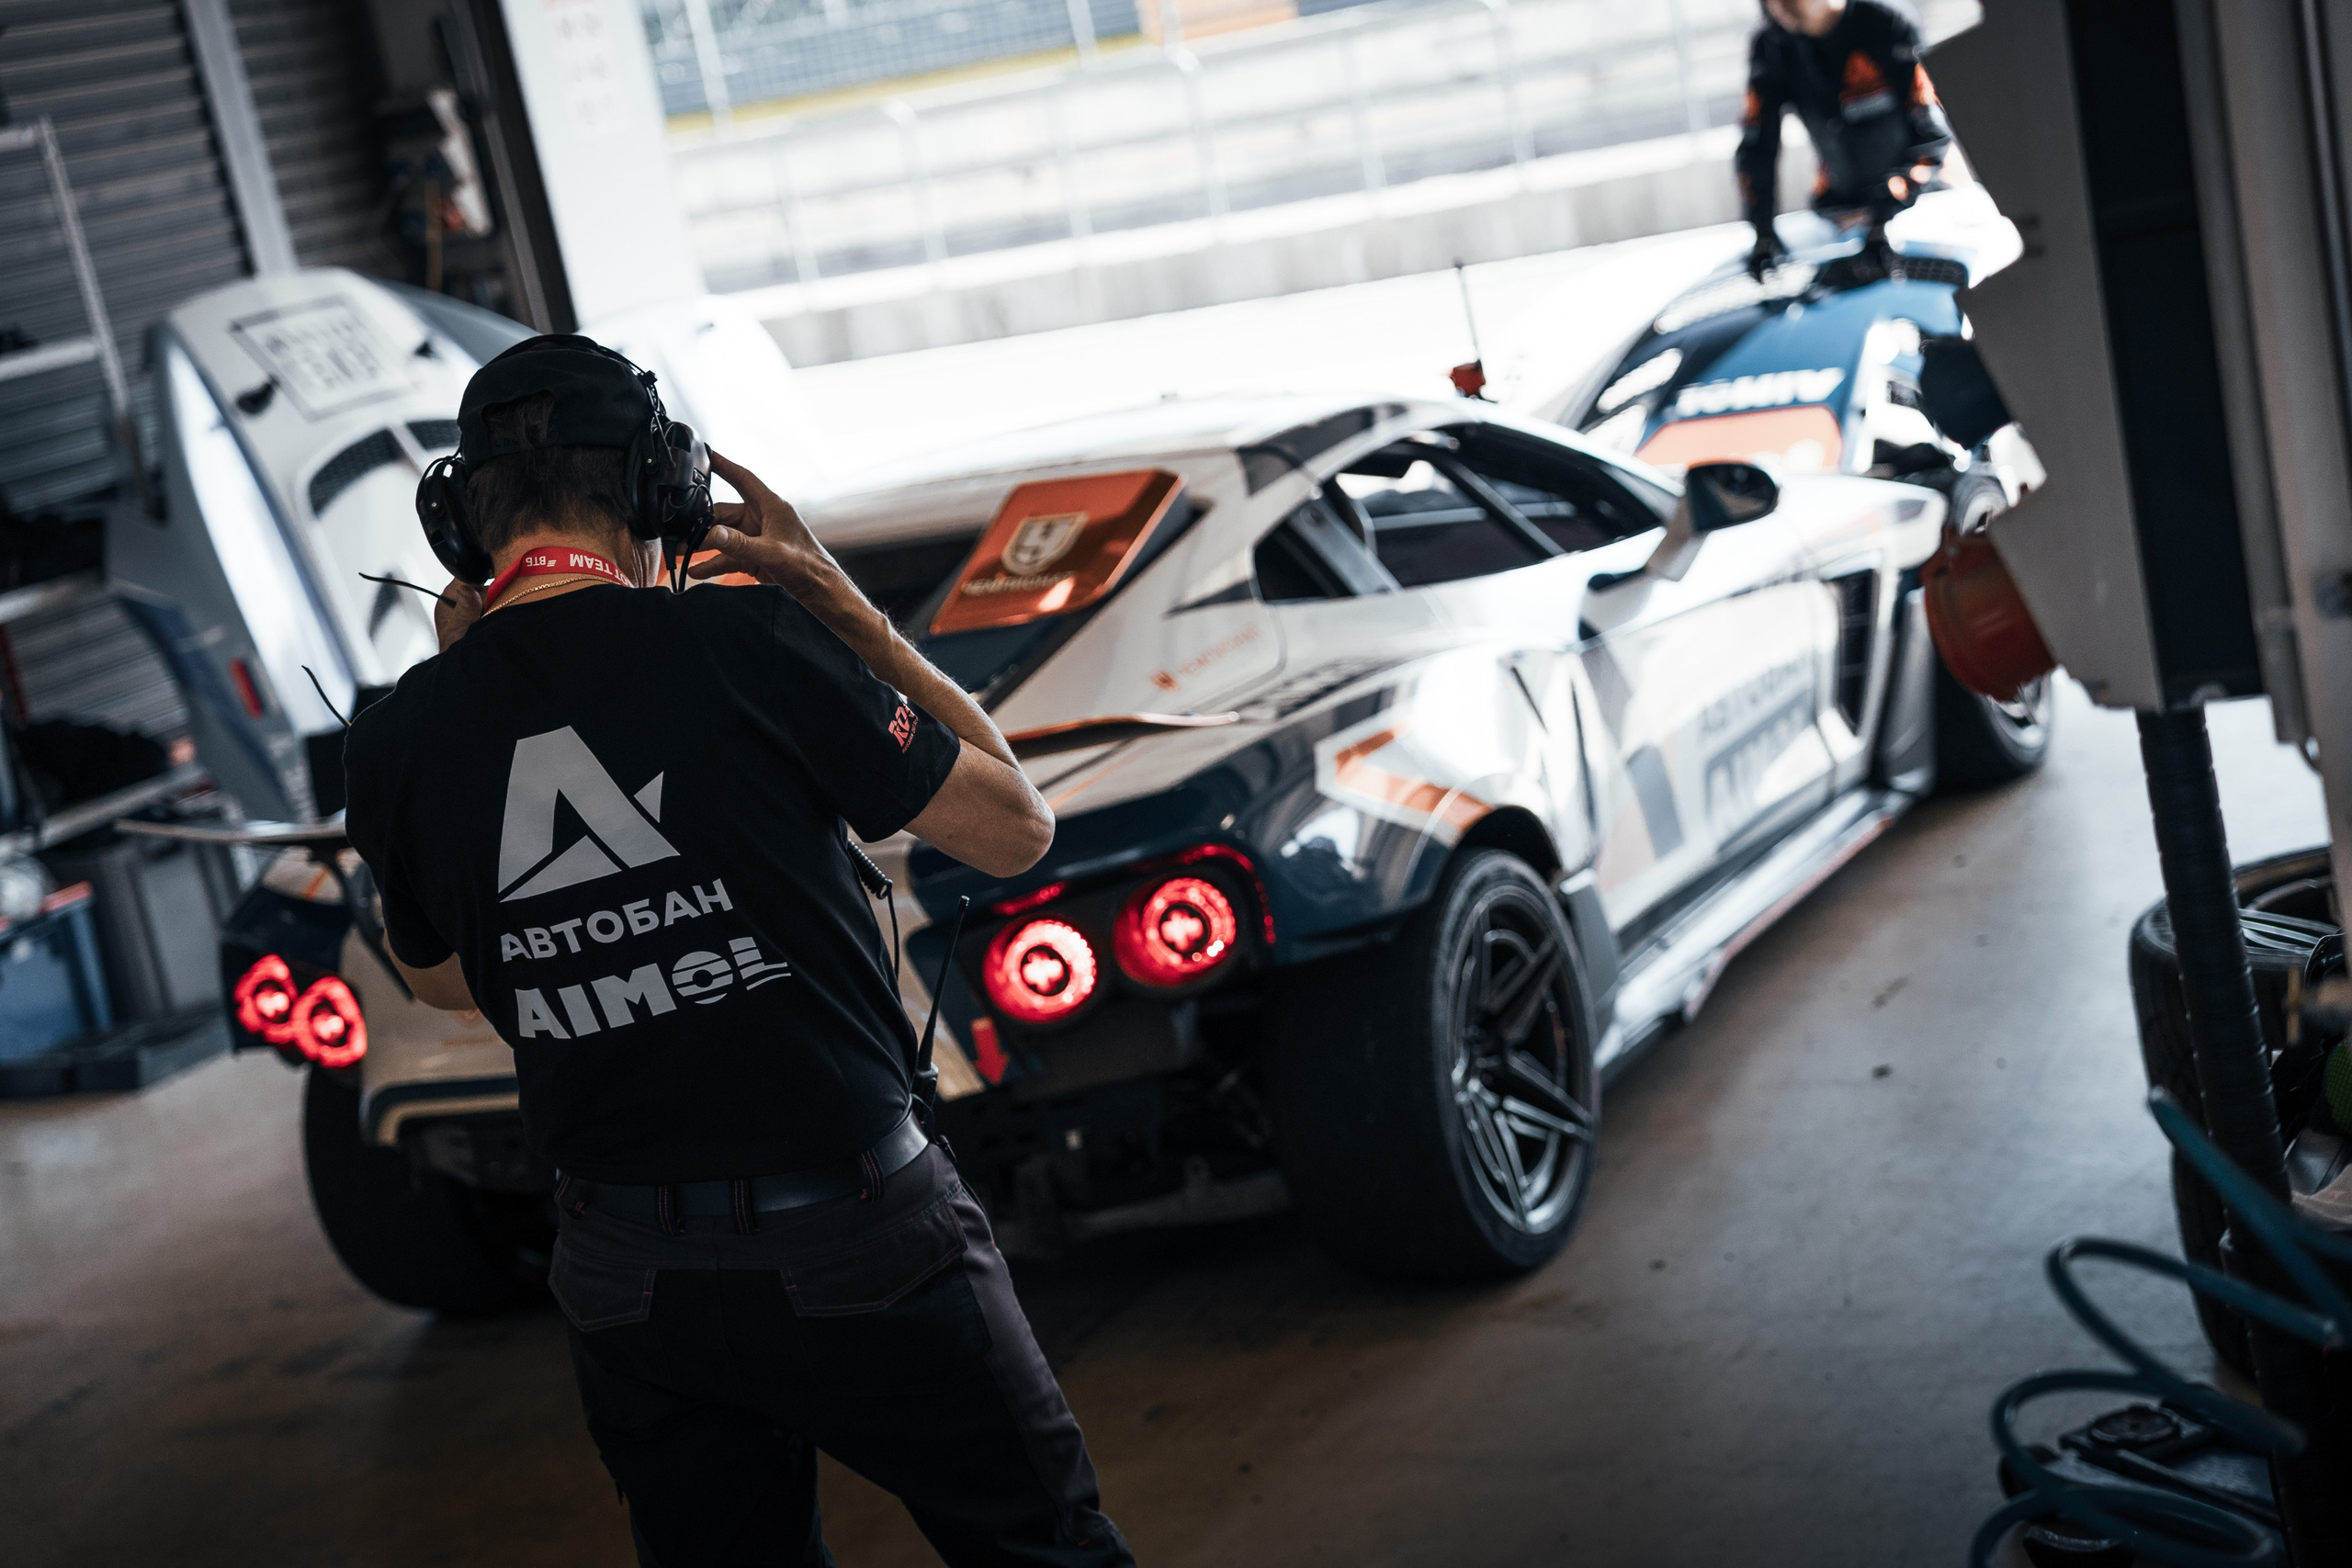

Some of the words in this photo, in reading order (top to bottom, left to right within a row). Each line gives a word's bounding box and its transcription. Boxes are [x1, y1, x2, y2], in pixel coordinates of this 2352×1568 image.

[525, 555, 547, 568] ВТБ
[569, 553, 613, 575] TEAM
[500, 877, 734, 963] АВТОБАН
[514, 936, 792, 1040] AIMOL
